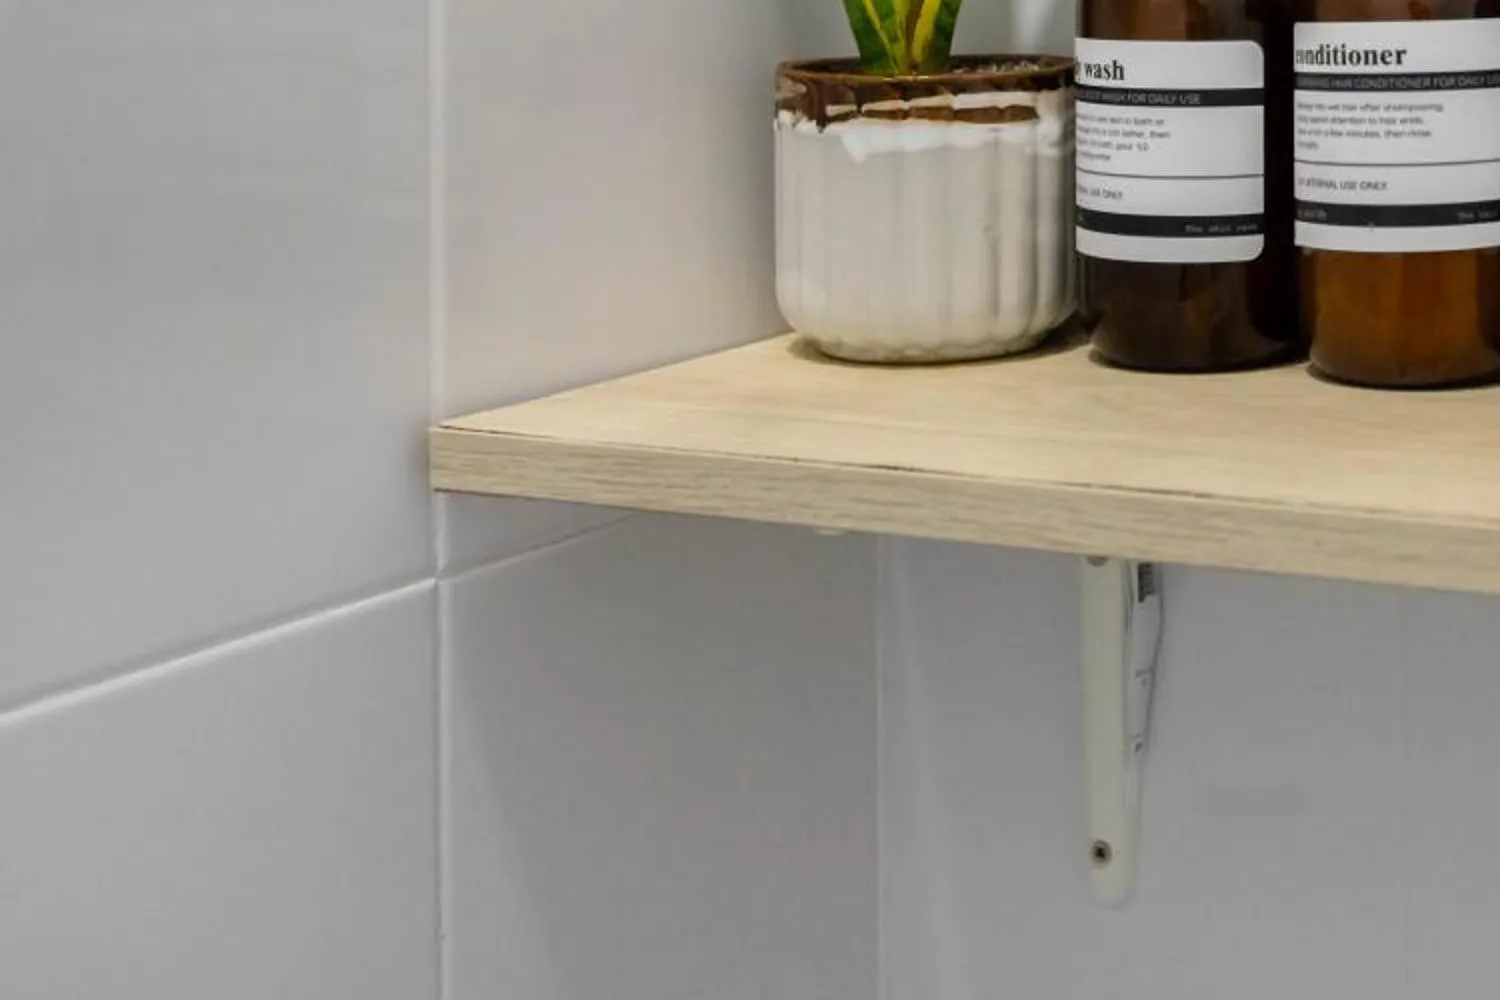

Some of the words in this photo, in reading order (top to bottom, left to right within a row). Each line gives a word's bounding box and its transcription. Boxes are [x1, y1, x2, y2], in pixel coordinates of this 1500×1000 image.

[1295, 43, 1407, 66] onditioner
[1084, 60, 1125, 81] wash
[1148, 94, 1176, 105] DAILY
[1179, 94, 1201, 105] USE
